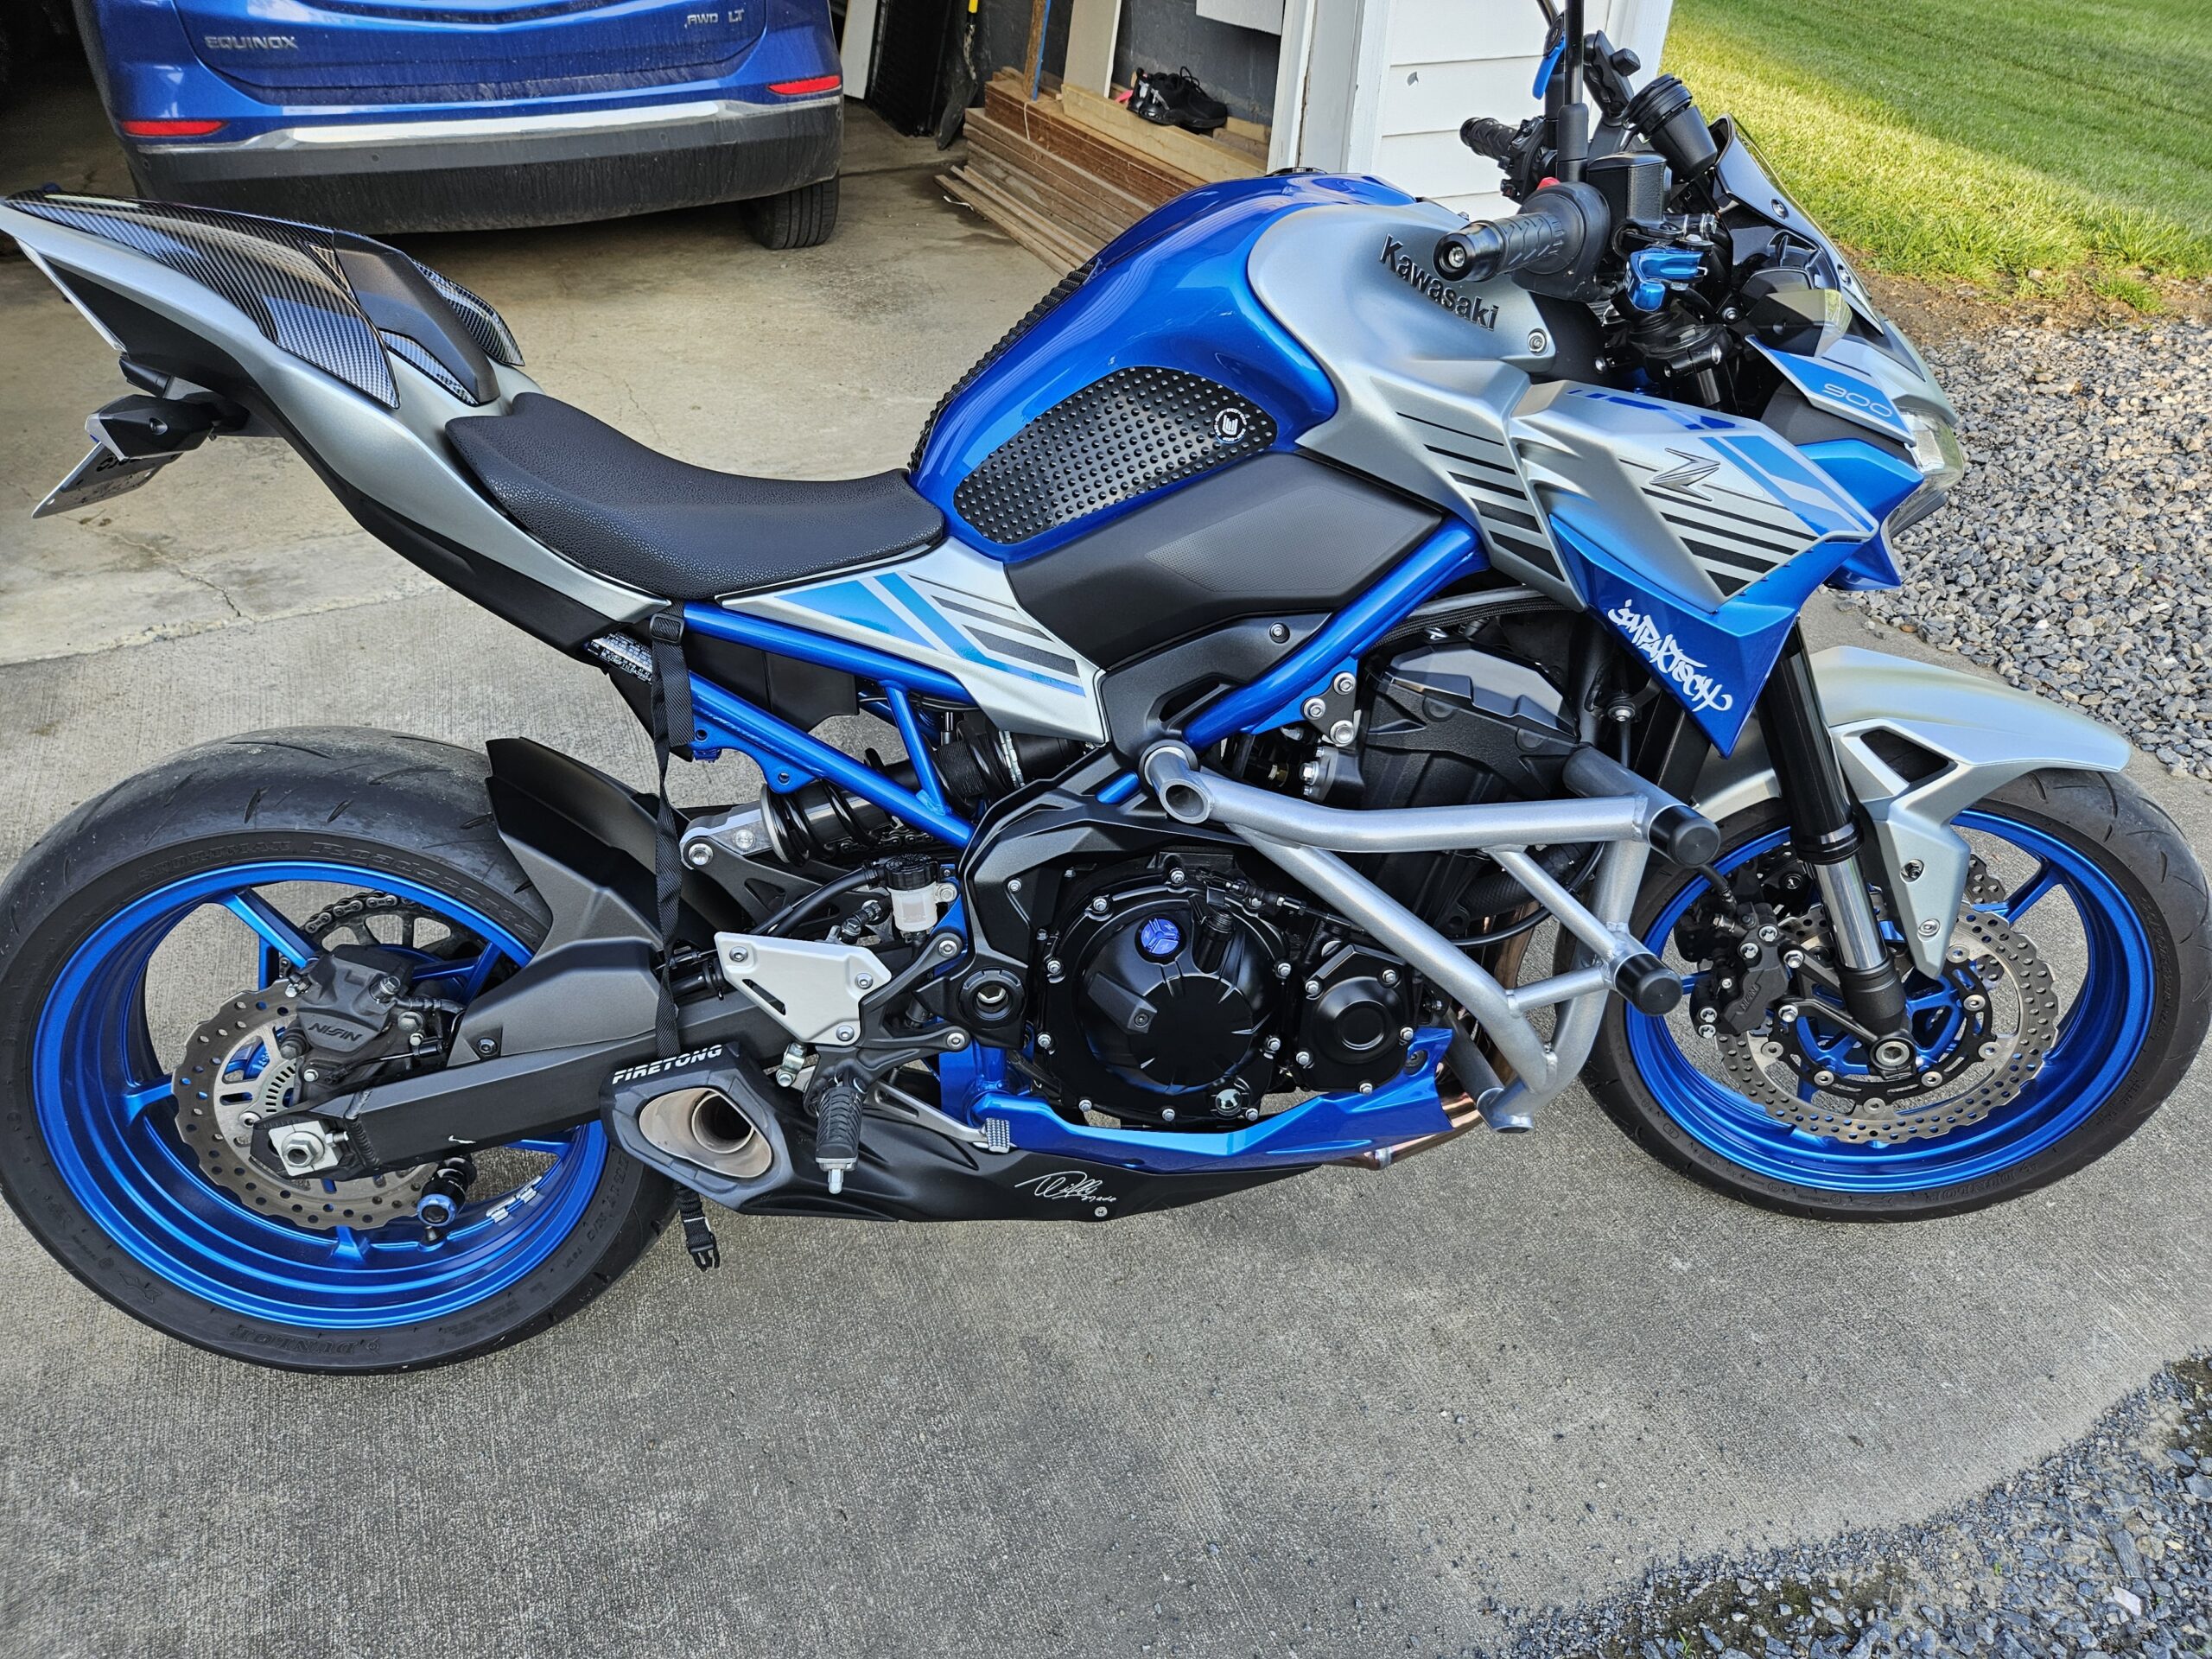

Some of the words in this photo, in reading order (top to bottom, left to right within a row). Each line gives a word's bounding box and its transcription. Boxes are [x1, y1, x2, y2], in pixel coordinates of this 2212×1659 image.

[687, 12, 719, 25] AWD
[728, 8, 745, 22] LT
[204, 35, 299, 49] EQUINOX
[1379, 232, 1500, 332] Kawasaki
[1821, 383, 1893, 417] 900
[612, 1044, 722, 1085] FIRETONG
